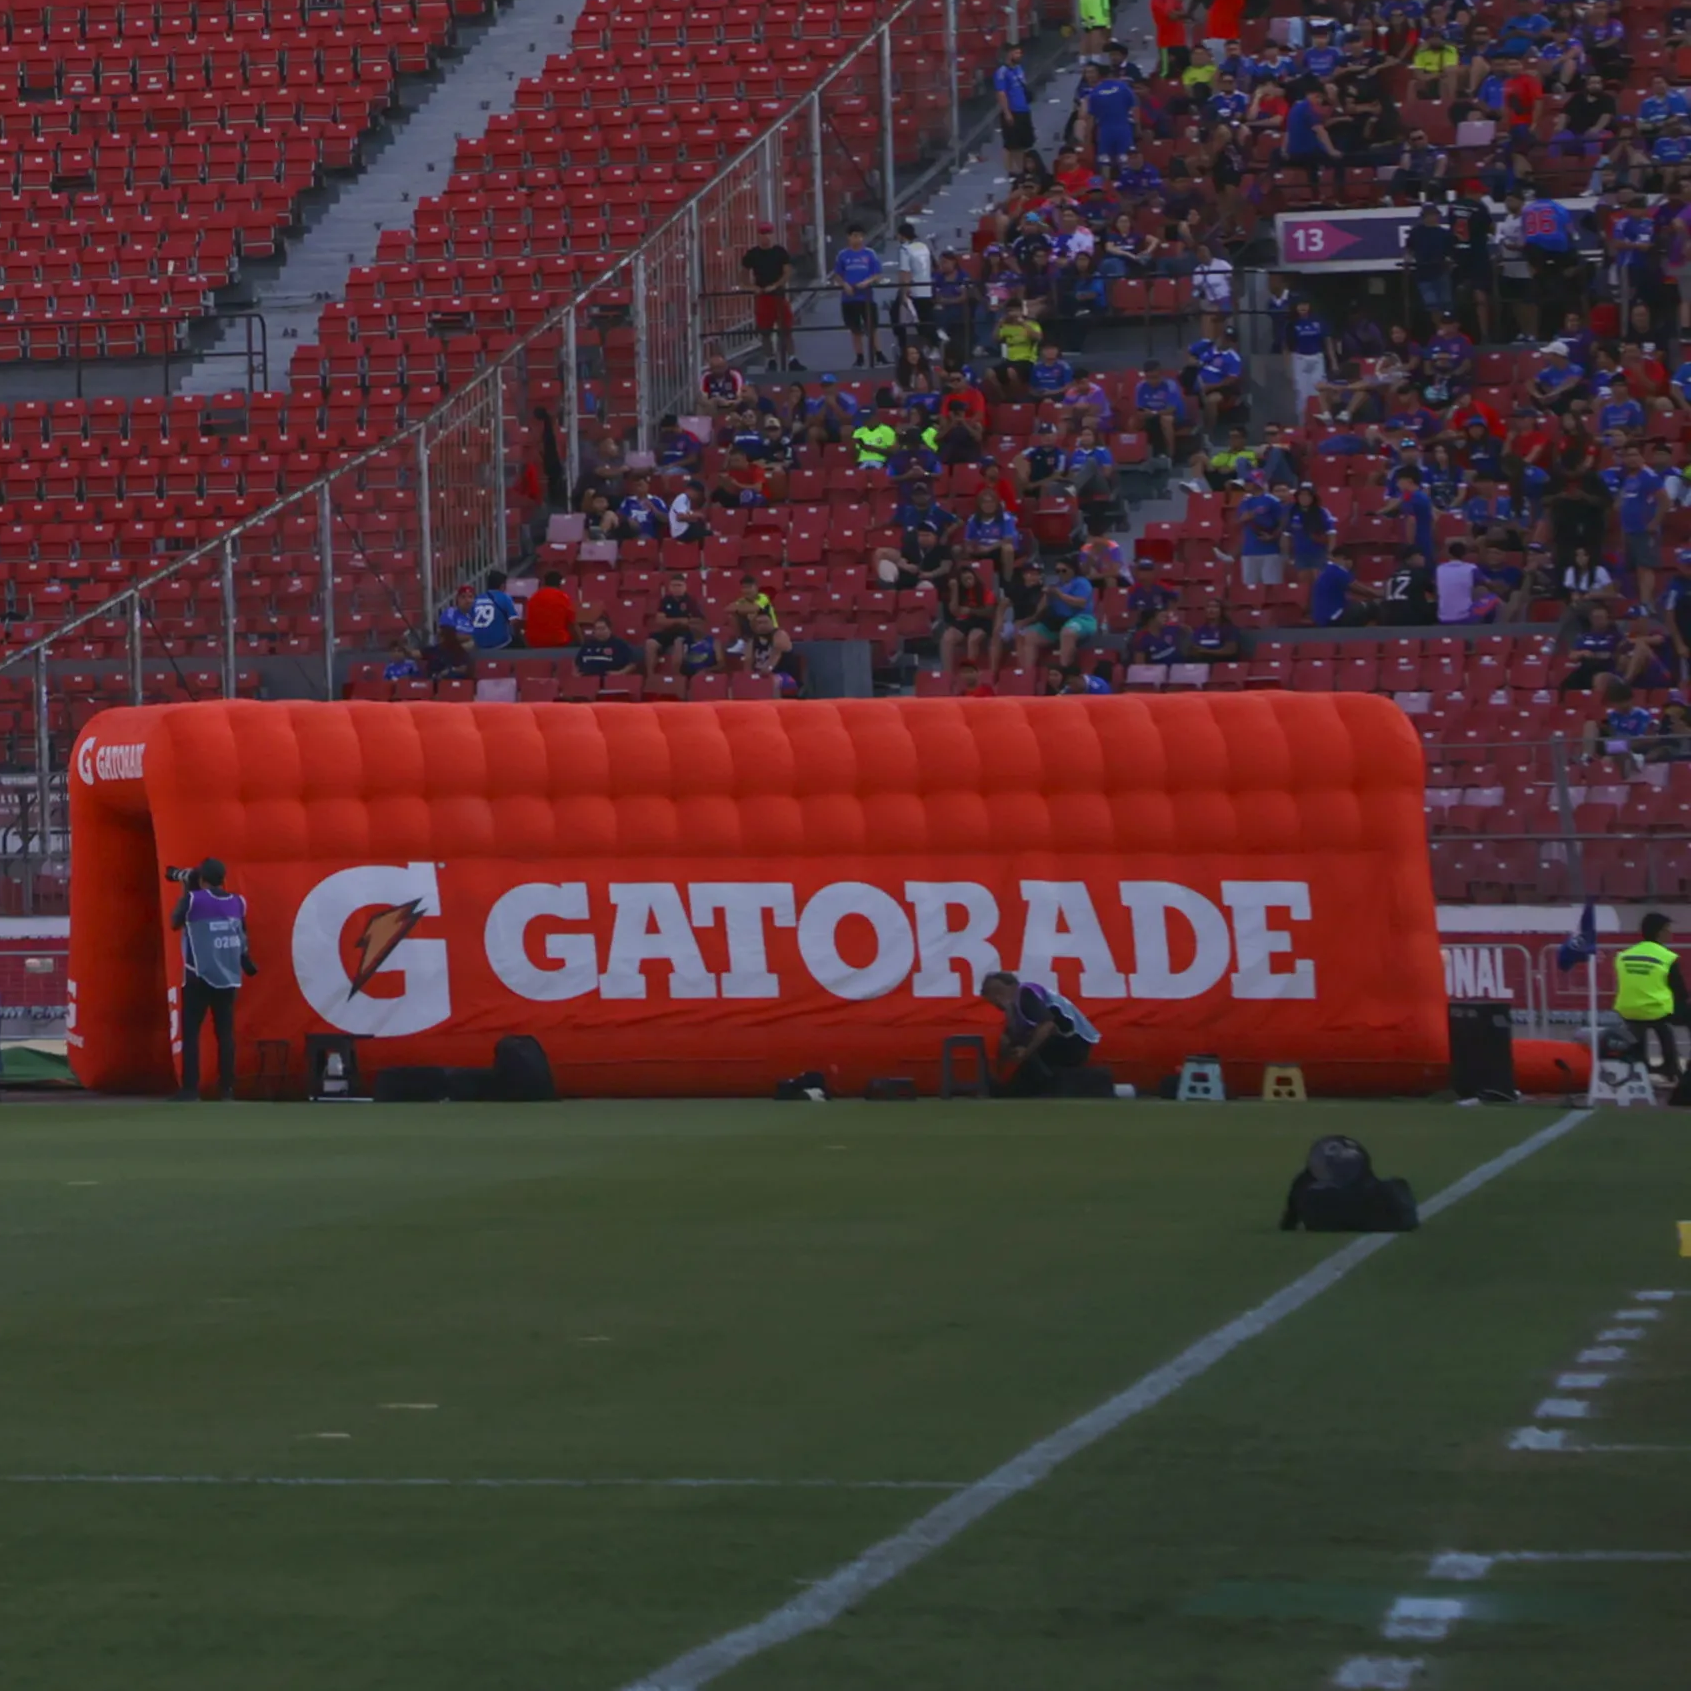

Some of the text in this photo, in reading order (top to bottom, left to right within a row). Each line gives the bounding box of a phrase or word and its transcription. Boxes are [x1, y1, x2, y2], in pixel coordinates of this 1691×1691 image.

[1292, 228, 1324, 252] 13
[291, 861, 451, 1037] G
[484, 879, 1317, 1001] GATORADE
